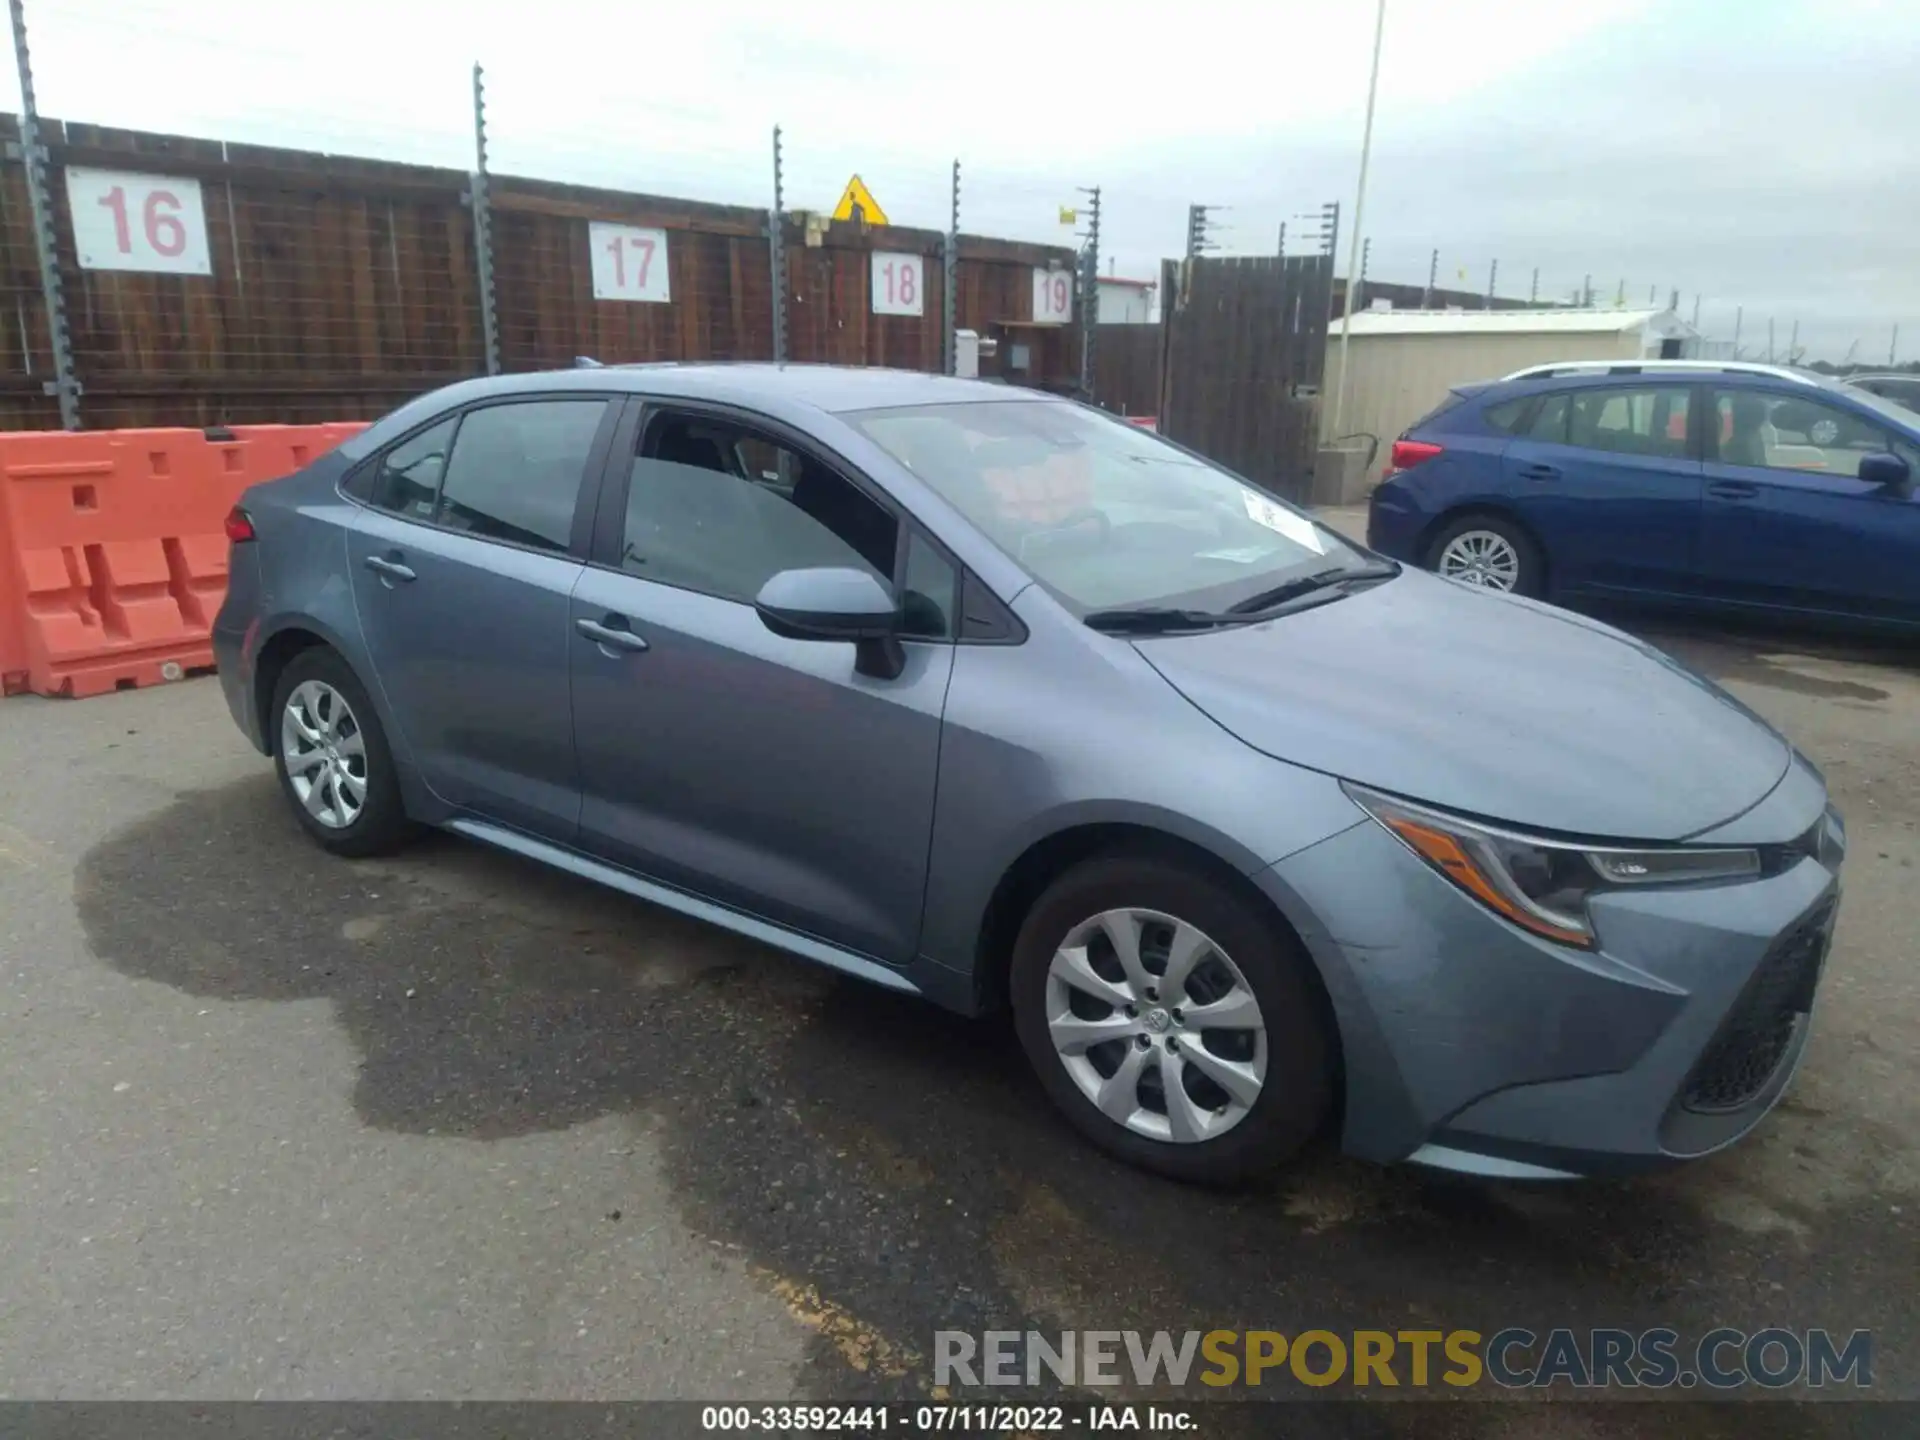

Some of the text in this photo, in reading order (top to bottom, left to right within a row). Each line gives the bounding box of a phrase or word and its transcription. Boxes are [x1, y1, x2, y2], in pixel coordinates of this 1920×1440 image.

[98, 186, 186, 257] 16
[606, 237, 655, 288] 17
[883, 262, 915, 305] 18
[1042, 275, 1067, 314] 19
